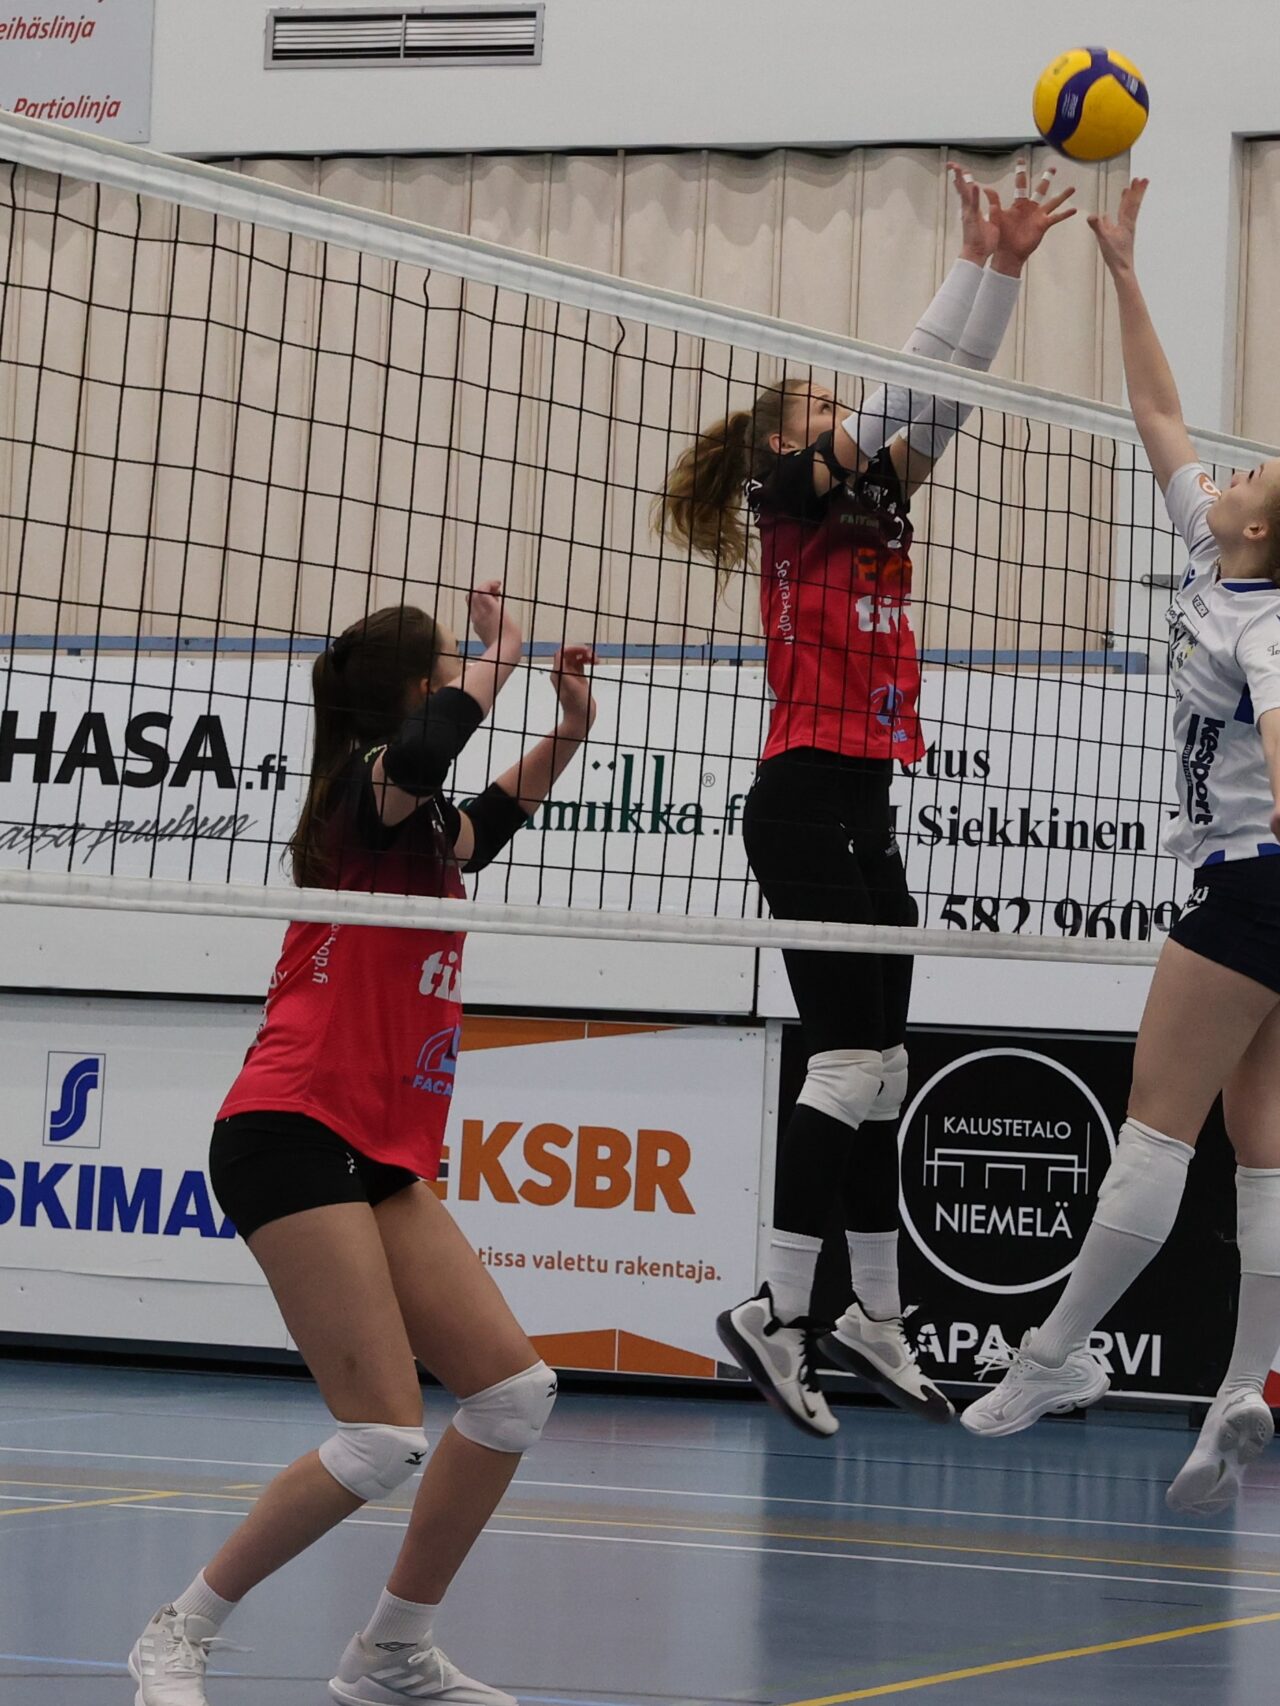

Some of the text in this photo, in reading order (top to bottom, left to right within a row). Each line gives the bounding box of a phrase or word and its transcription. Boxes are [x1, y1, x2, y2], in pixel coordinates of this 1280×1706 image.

[13, 95, 122, 124] Partiolinja
[917, 804, 1147, 851] Siekkinen
[943, 1116, 1072, 1139] KALUSTETALO
[458, 1119, 697, 1215] KSBR
[935, 1201, 1073, 1239] NIEMELÄ
[532, 1250, 608, 1273] valettu
[615, 1256, 722, 1284] rakentaja.
